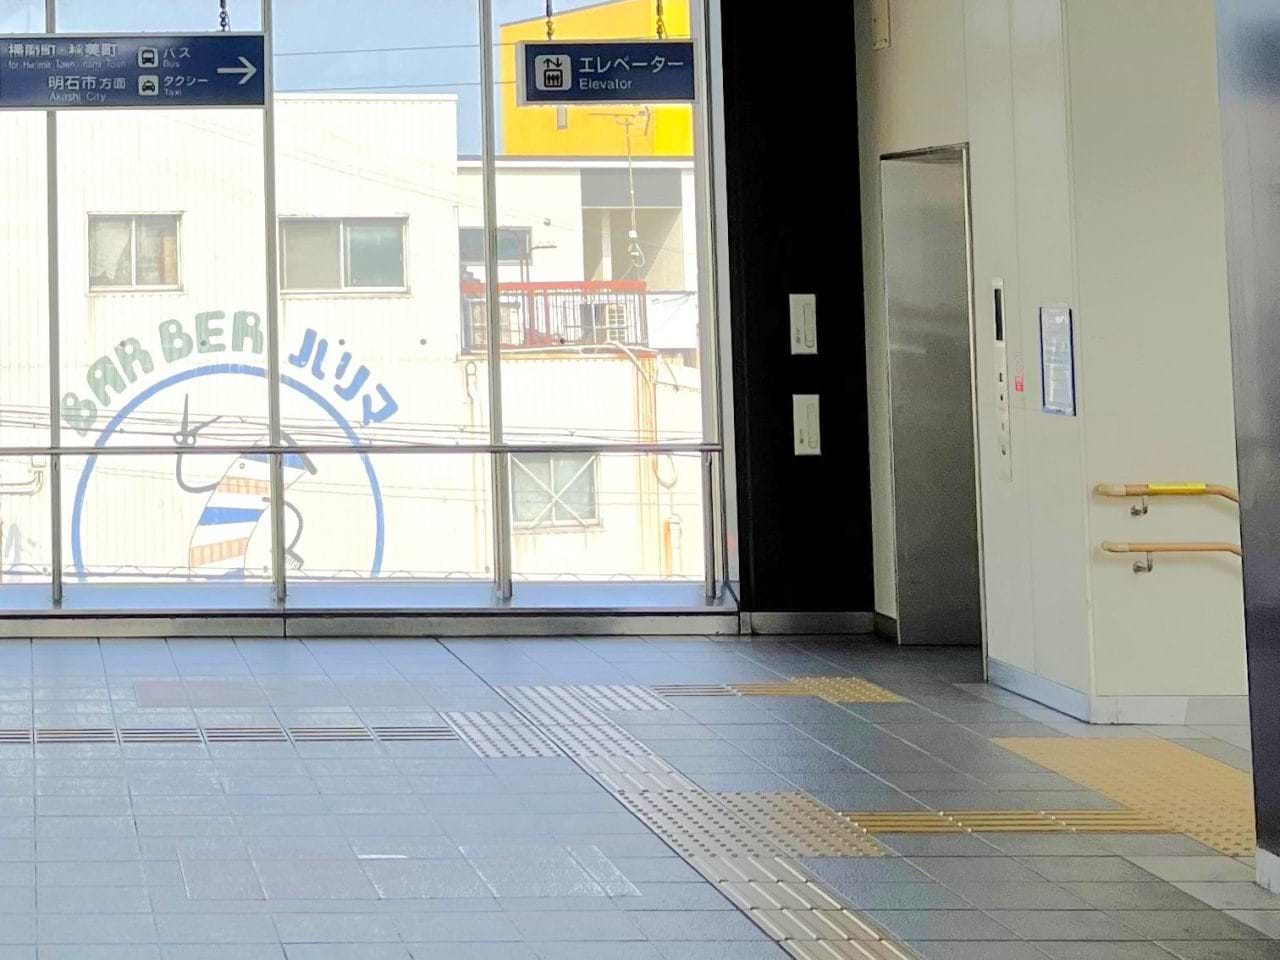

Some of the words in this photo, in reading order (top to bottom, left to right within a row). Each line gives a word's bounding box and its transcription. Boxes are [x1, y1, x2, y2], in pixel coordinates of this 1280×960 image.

[163, 47, 191, 58] バス
[163, 59, 180, 68] Bus
[579, 55, 684, 73] エレベーター
[163, 75, 208, 87] タクシー
[579, 78, 632, 90] Elevator
[49, 92, 81, 102] Akashi
[86, 91, 106, 103] City
[164, 88, 182, 96] Taxi
[61, 310, 264, 437] BARBER
